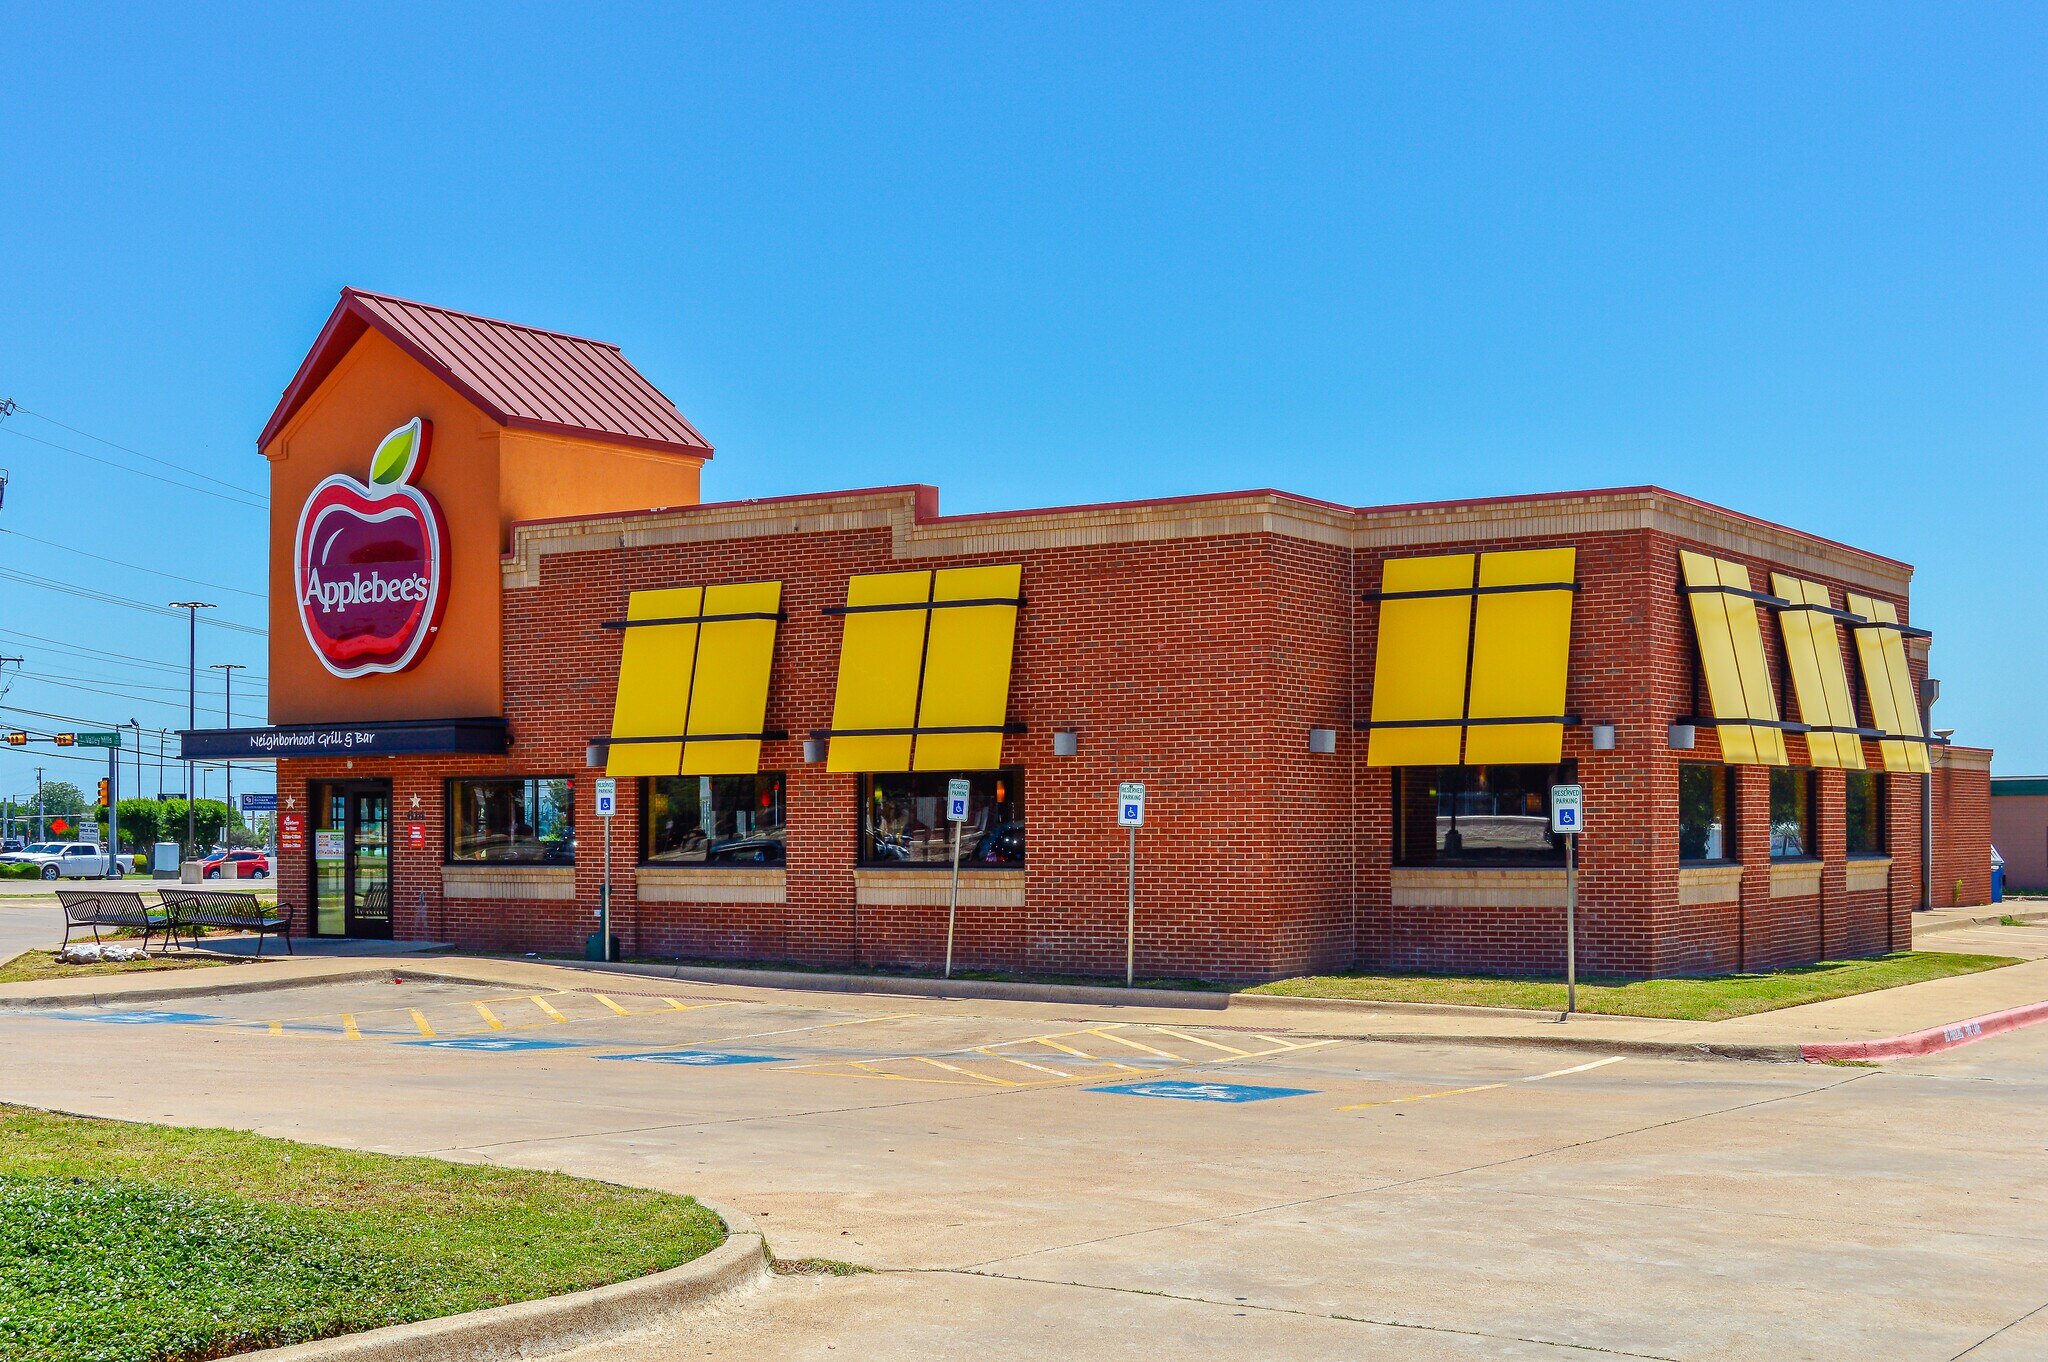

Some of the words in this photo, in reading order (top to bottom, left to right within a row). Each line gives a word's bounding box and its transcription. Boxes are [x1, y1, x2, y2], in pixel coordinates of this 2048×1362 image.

[303, 567, 428, 613] Applebee's
[84, 735, 101, 745] Valley
[101, 735, 112, 744] Mills
[250, 732, 315, 751] Neighborhood
[318, 731, 342, 747] Grill
[344, 732, 353, 748] &
[354, 732, 376, 744] Bar
[1554, 789, 1580, 797] RESERVED
[1556, 797, 1578, 805] PARKING
